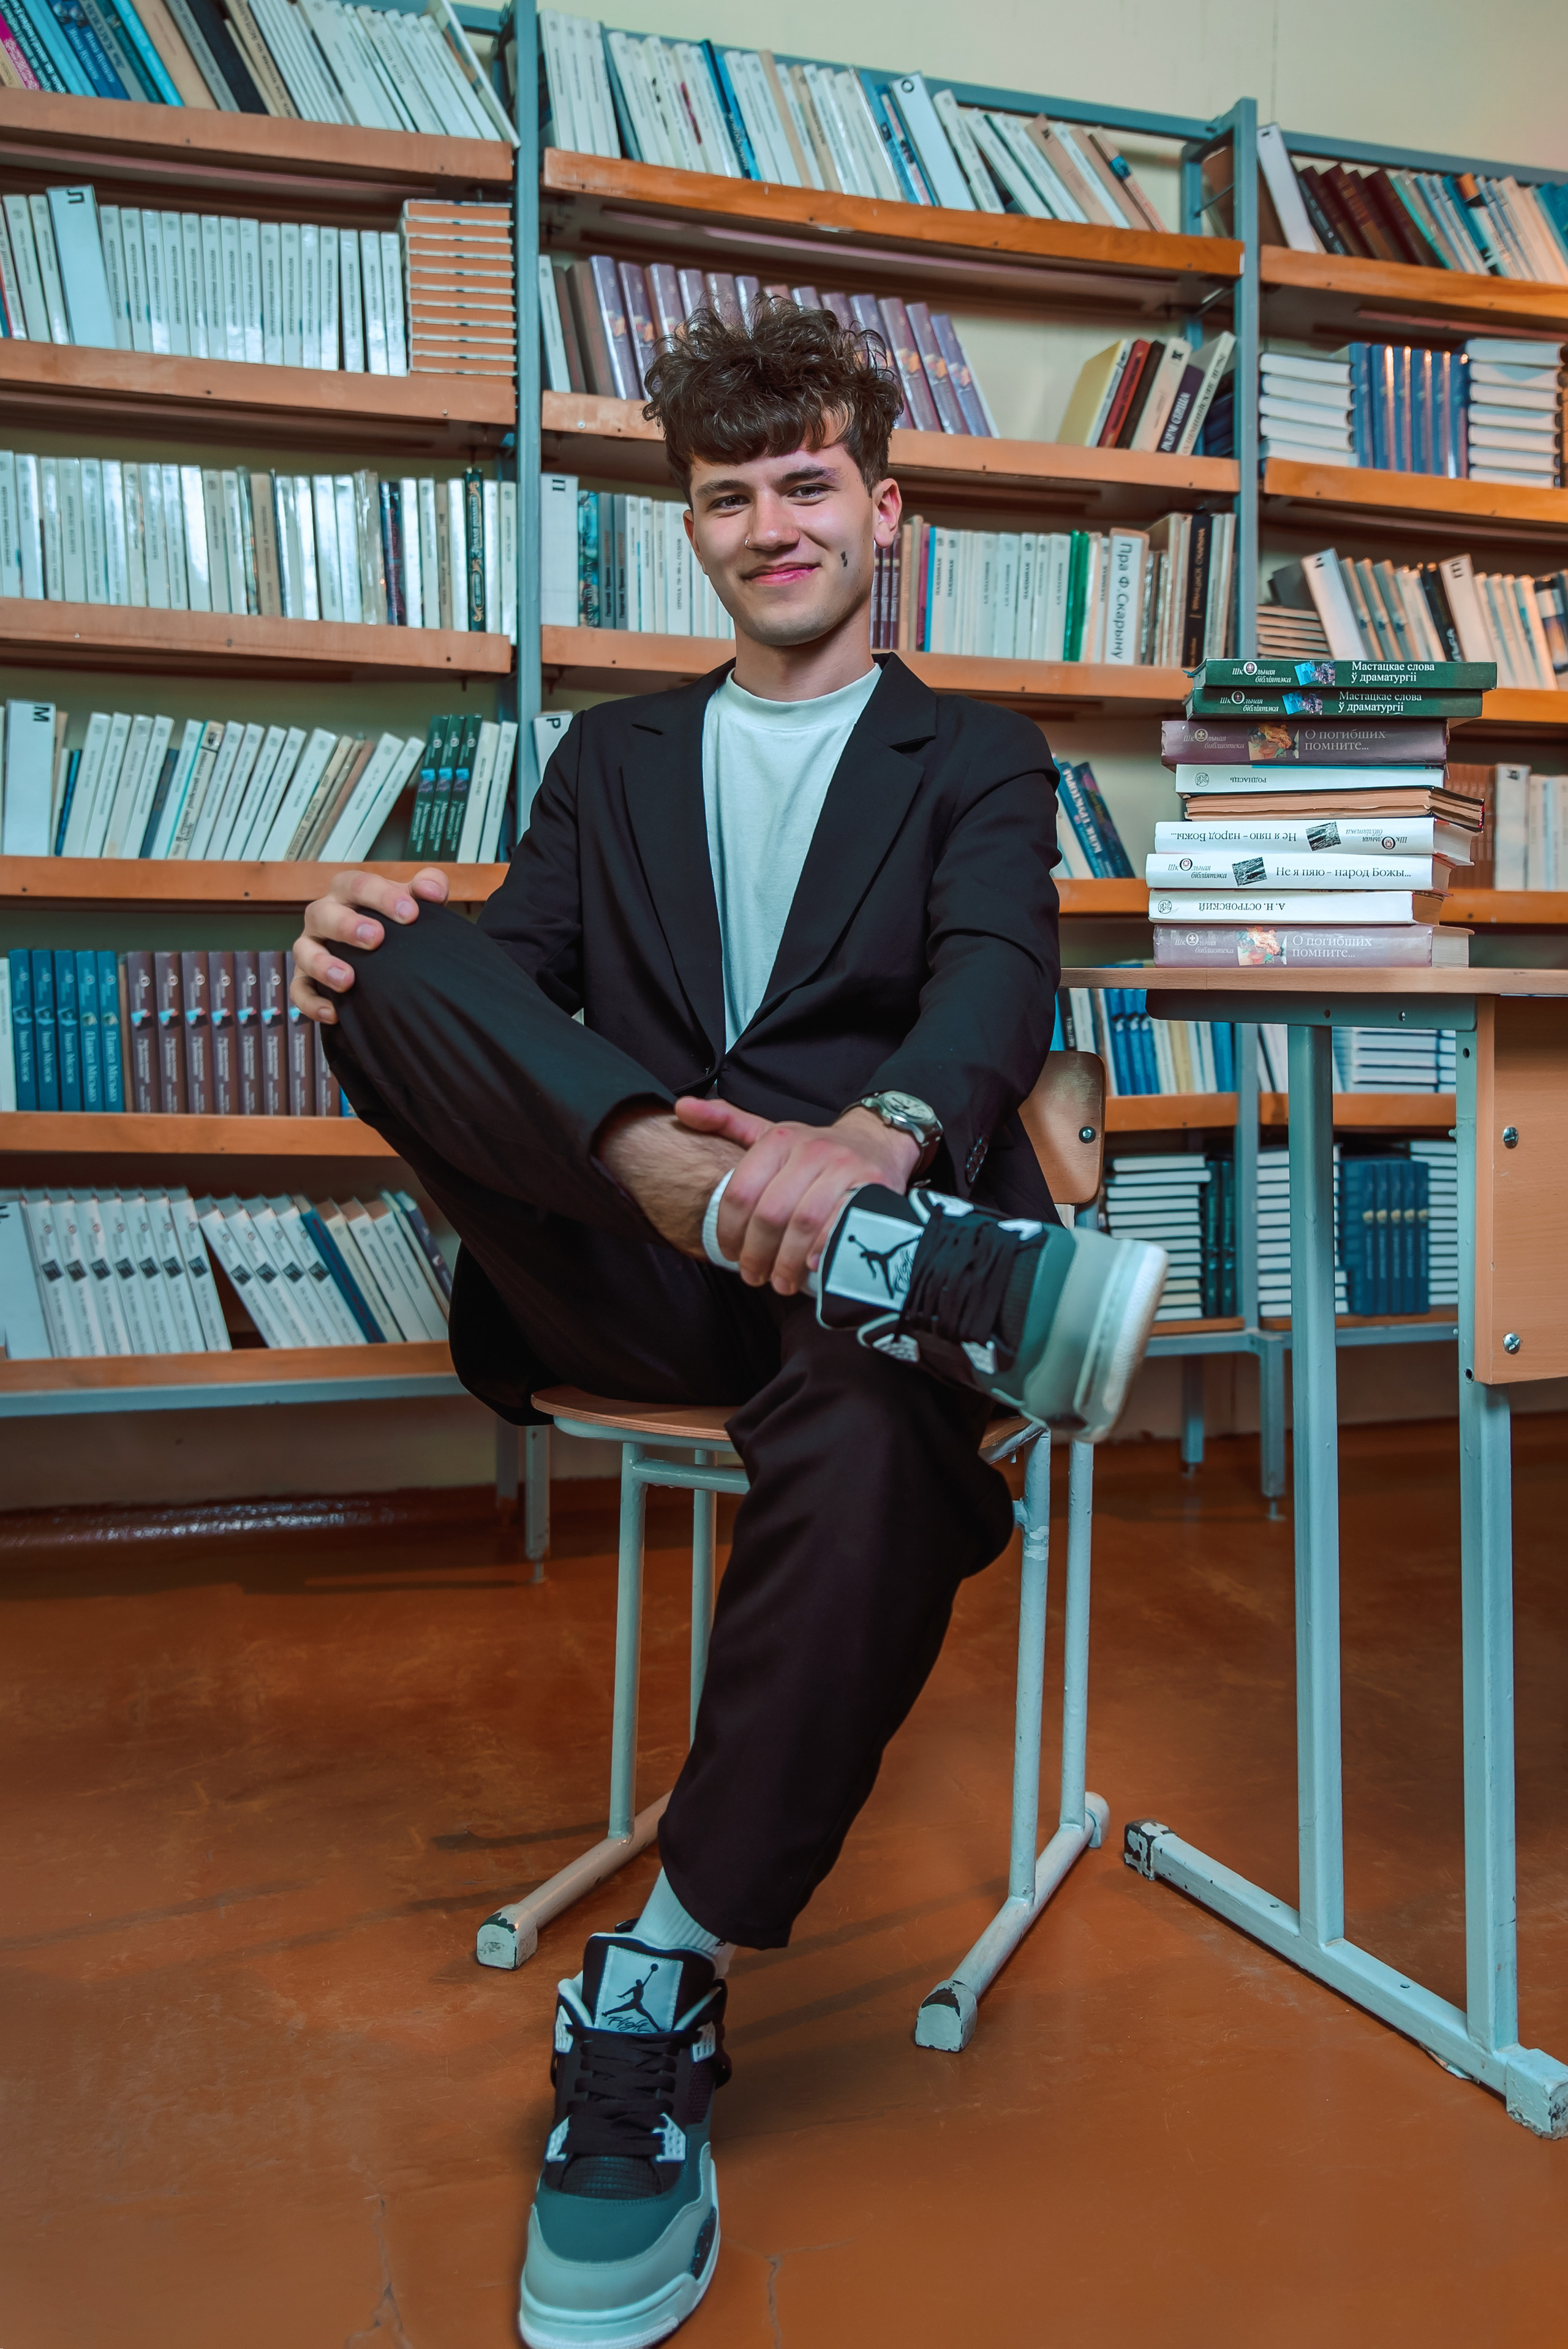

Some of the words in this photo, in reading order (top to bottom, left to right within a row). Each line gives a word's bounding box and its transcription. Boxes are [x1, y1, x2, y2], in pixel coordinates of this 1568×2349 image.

[1117, 543, 1132, 571] Пра
[1111, 576, 1129, 659] Ф.Скарыну
[1351, 661, 1405, 672] Мастацкае
[1407, 663, 1435, 672] слова
[1255, 676, 1292, 684] бібліятэка
[1351, 673, 1358, 683] ў
[1360, 673, 1417, 683] драматургіі
[1339, 691, 1392, 702] Мастацкае
[1338, 703, 1344, 713] ў
[1347, 703, 1404, 713] драматургіі
[1305, 730, 1316, 740] О
[1319, 729, 1386, 741] погибших
[1305, 742, 1369, 751] помните...
[1170, 832, 1206, 842] Божы...
[1209, 831, 1241, 840] народ
[1282, 832, 1297, 841] Не
[1345, 828, 1383, 837] бібліятэка
[1191, 871, 1227, 880] бібліятэка
[1276, 867, 1291, 877] Не
[1335, 869, 1370, 879] народ
[1372, 867, 1411, 878] Божы...
[1198, 902, 1262, 911] ОСТРОВСКИЙ
[1292, 935, 1303, 946] О
[1306, 935, 1372, 947] погибших
[1292, 948, 1355, 958] помните...
[608, 2016, 652, 2033] Flight
